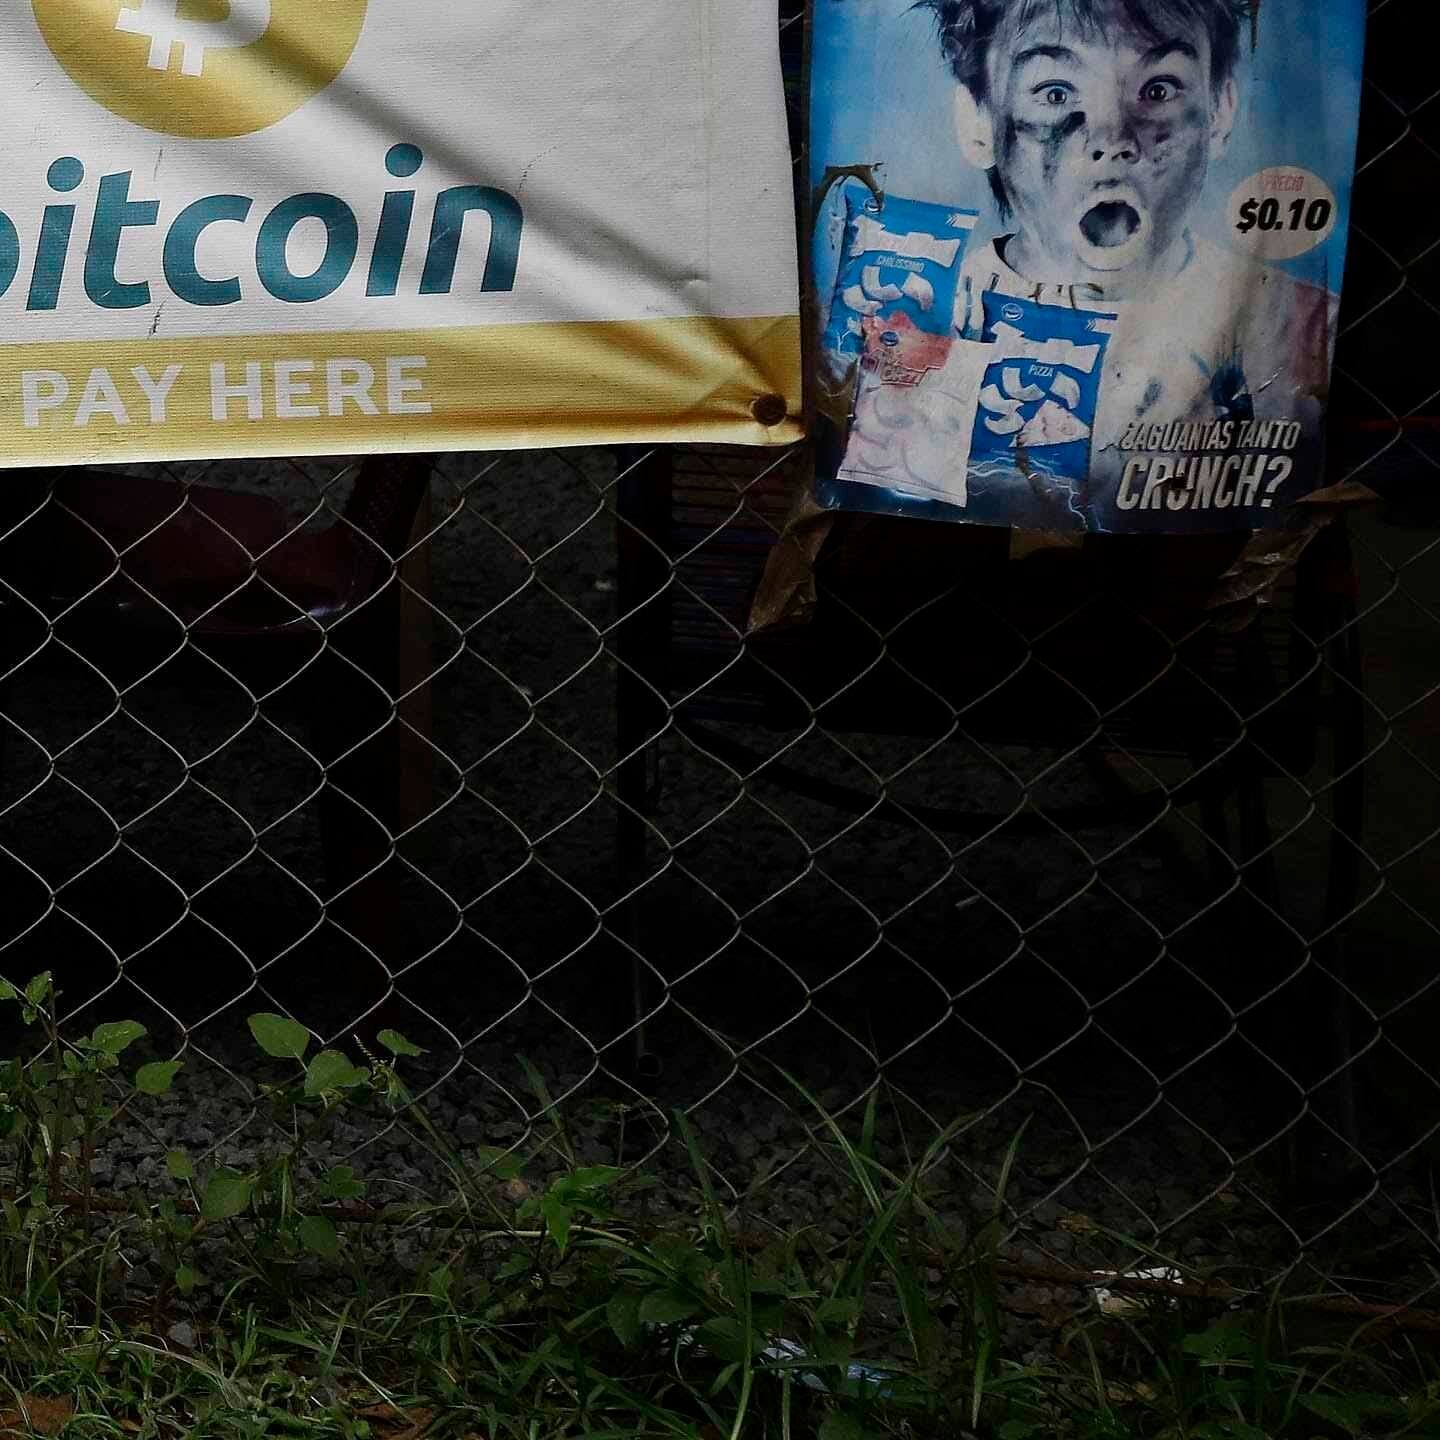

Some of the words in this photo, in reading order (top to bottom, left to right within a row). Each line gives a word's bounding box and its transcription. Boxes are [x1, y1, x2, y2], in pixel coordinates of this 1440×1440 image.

[1236, 197, 1332, 234] $0.10
[1028, 364, 1055, 377] PIZZA
[20, 364, 182, 428] PAY
[208, 357, 433, 422] HERE
[1235, 418, 1302, 450] TANTO
[1115, 454, 1294, 510] CRUNCH?
